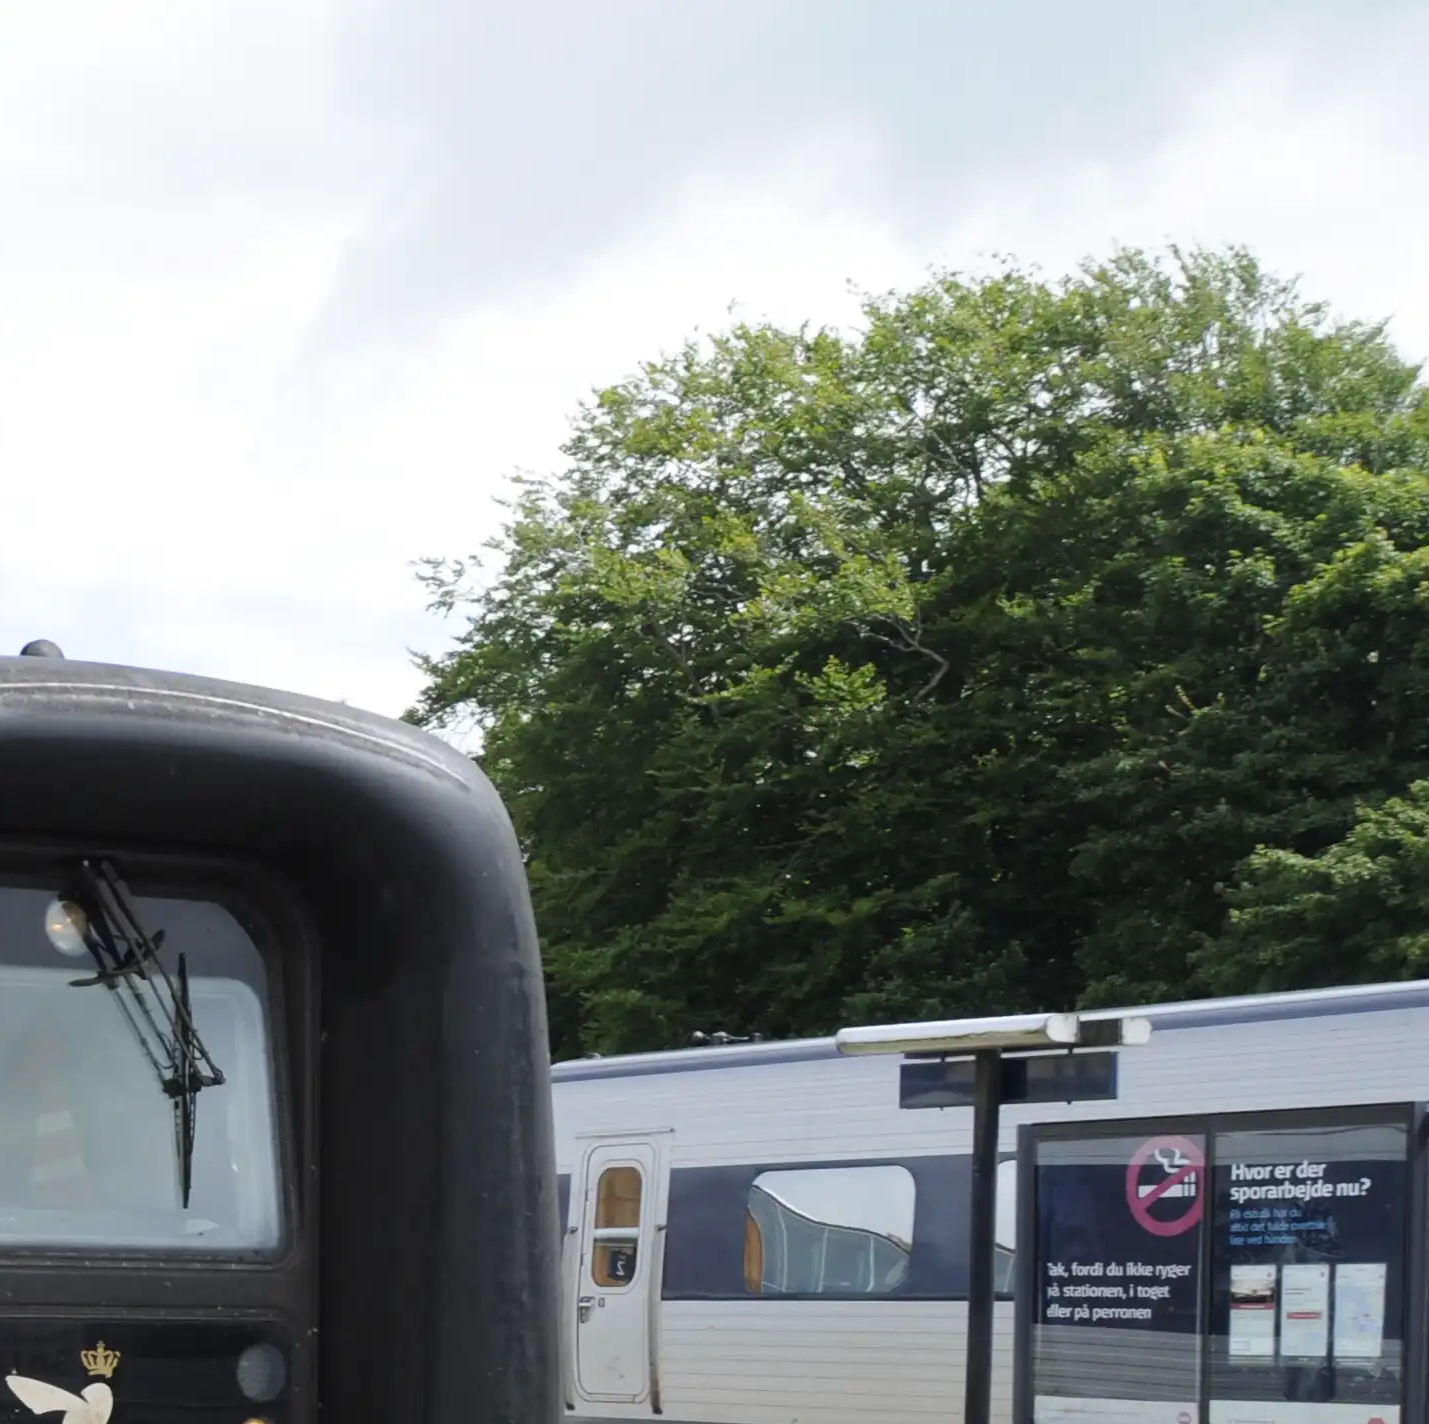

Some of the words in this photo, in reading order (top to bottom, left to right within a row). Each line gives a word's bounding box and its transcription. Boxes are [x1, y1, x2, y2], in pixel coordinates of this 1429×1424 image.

[1230, 1163, 1273, 1181] Hvor
[1274, 1165, 1295, 1179] er
[1296, 1160, 1327, 1179] der
[1230, 1179, 1334, 1204] sporarbejde
[1335, 1177, 1372, 1197] nu?
[1070, 1261, 1104, 1276] fordi
[1106, 1261, 1124, 1276] du
[1126, 1261, 1153, 1276] ikke
[1155, 1264, 1192, 1280] ryger
[1063, 1283, 1127, 1300] stationen,
[1136, 1286, 1171, 1300] toget
[1046, 1303, 1073, 1318] eller
[1074, 1303, 1090, 1321] på
[1092, 1307, 1152, 1322] perronen
